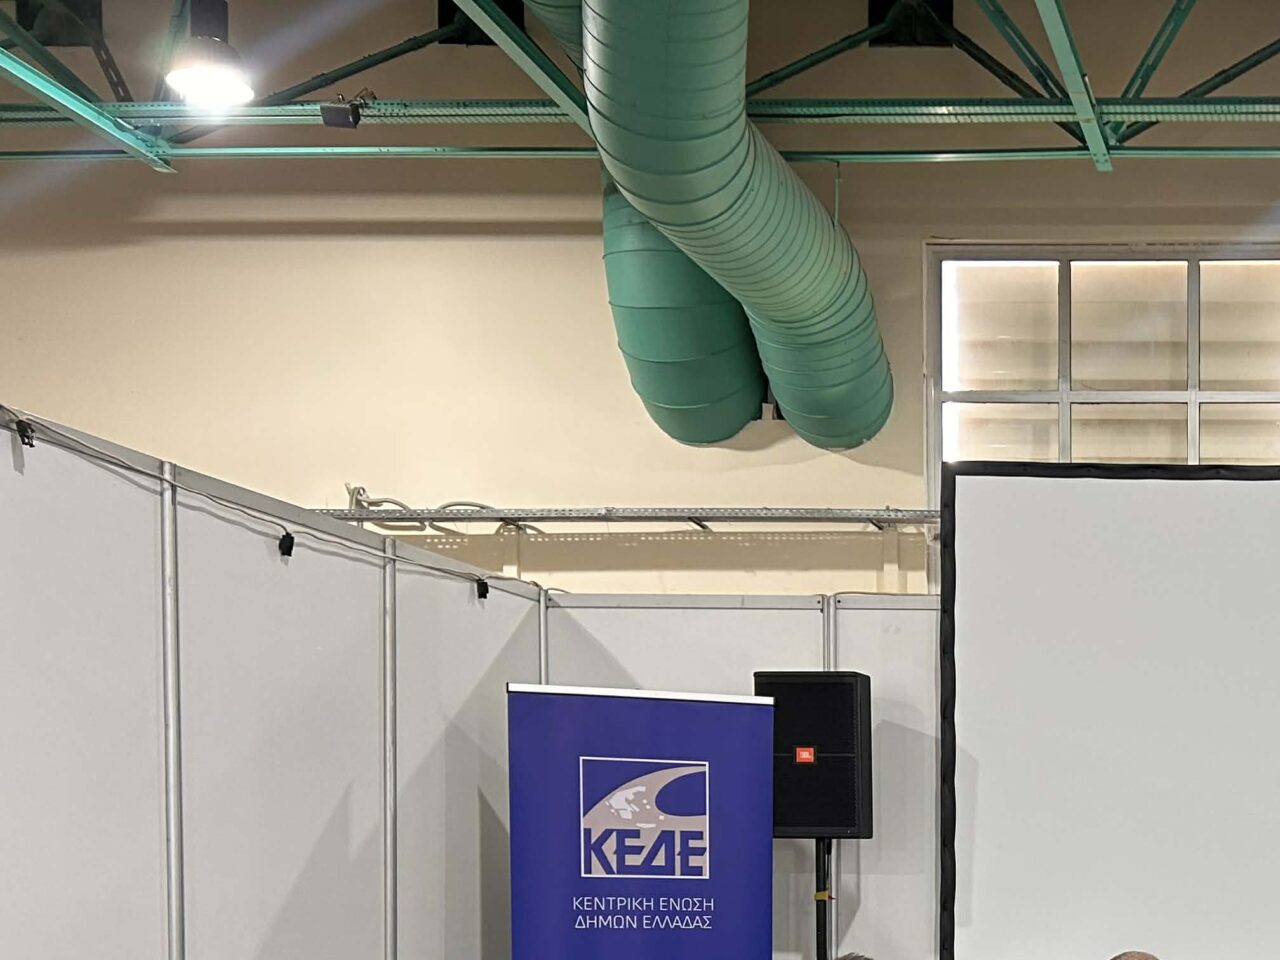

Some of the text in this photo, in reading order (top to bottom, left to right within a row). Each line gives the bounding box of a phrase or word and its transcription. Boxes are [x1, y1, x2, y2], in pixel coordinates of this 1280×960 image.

[583, 827, 707, 877] ΚΕΔΕ
[572, 896, 714, 911] ΚΕΝΤΡΙΚΗ ΕΝΩΣΗ
[574, 915, 713, 929] ΔΗΜΩΝ ΕΛΛΑΔΑΣ
